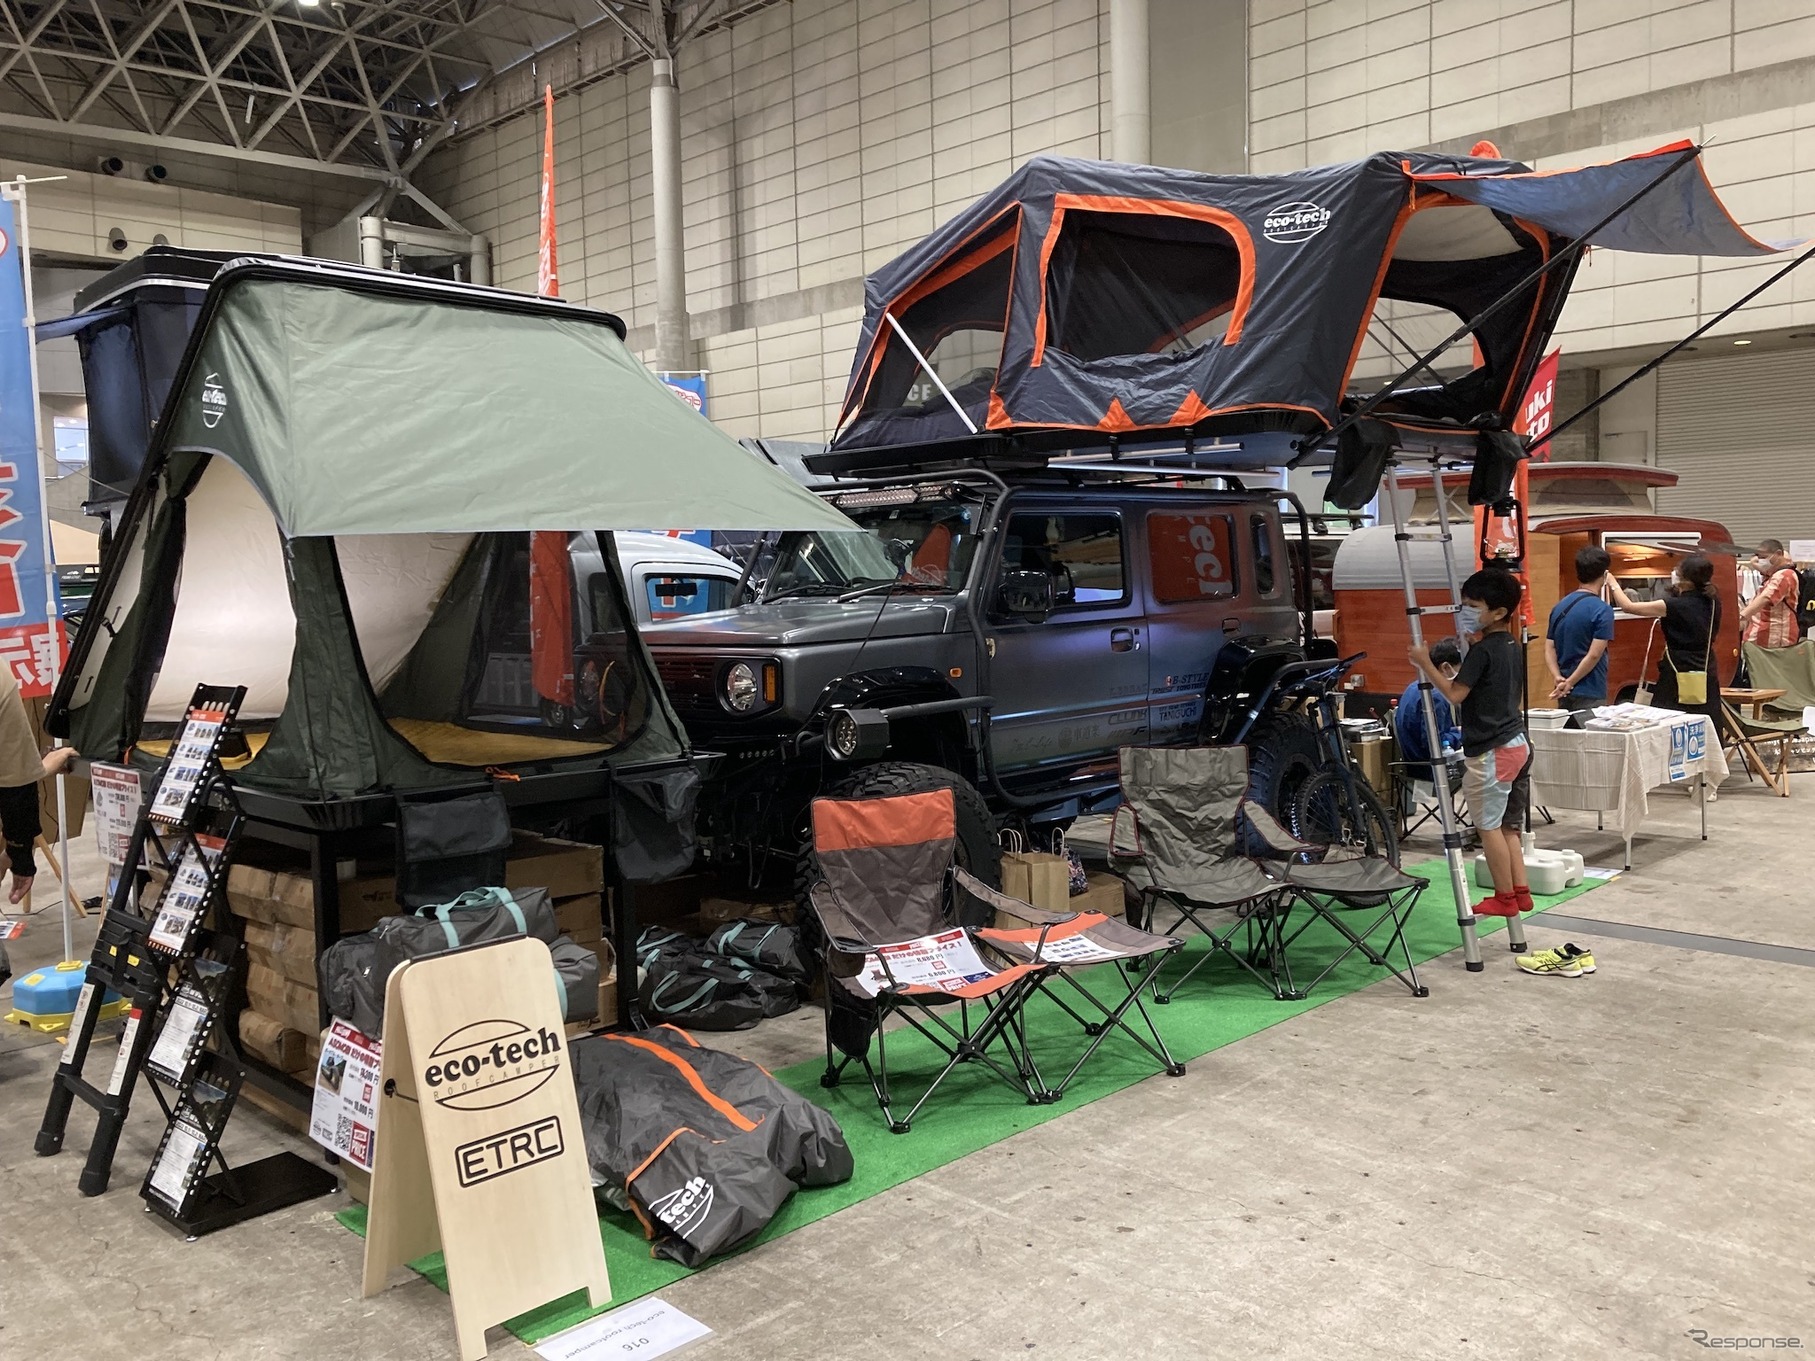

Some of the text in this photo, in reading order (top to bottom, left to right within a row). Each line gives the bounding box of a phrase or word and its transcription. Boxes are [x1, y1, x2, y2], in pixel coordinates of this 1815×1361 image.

[1264, 207, 1331, 228] eco-tech
[425, 1027, 561, 1087] eco-tech
[433, 1055, 560, 1100] ROOFCAMPER
[462, 1123, 559, 1179] ETRC
[622, 1337, 650, 1352] 016
